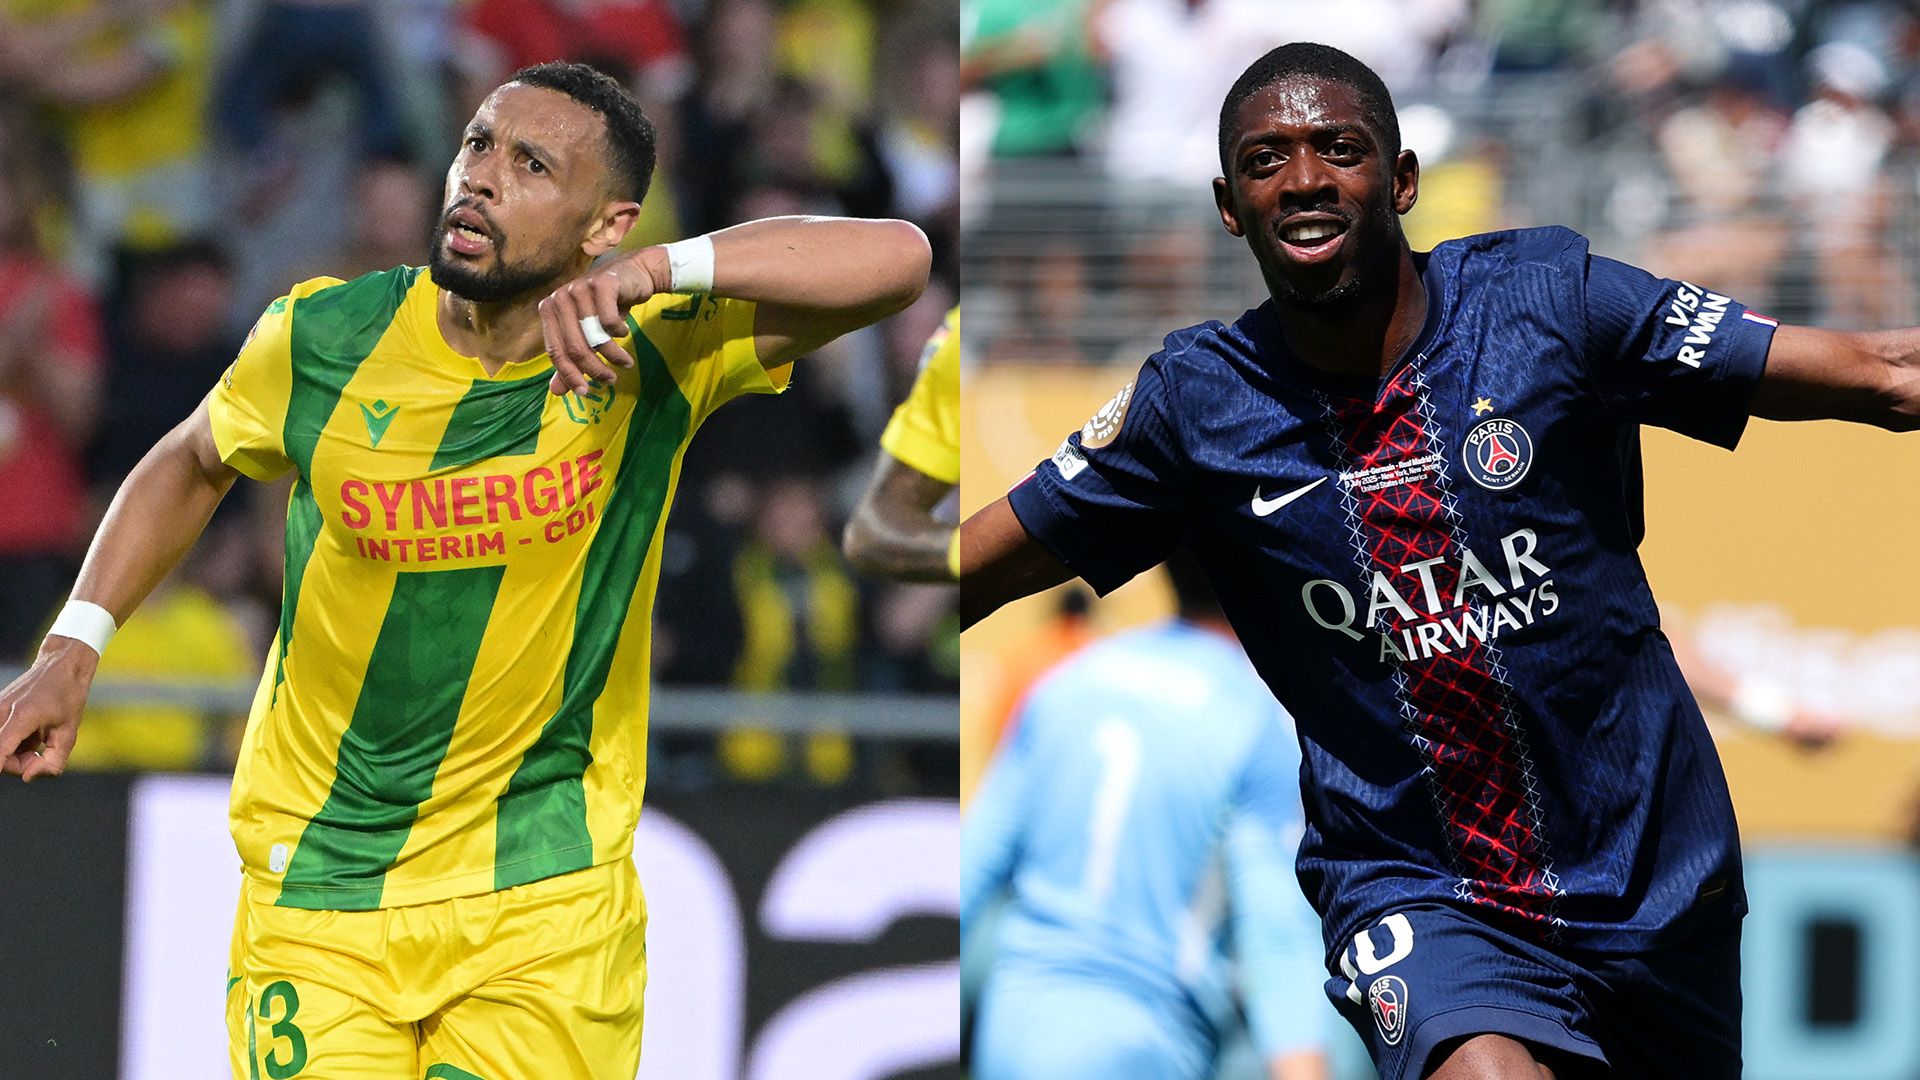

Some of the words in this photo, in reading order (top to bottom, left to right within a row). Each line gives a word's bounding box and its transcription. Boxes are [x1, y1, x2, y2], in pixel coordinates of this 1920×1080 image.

[1469, 421, 1514, 446] PARIS
[1398, 460, 1412, 468] Real
[1411, 455, 1432, 466] Madrid
[1361, 482, 1380, 493] United
[1379, 479, 1398, 489] States
[1404, 474, 1428, 483] America
[1362, 475, 1378, 485] 2025
[1381, 471, 1395, 480] New
[1409, 466, 1422, 474] New
[1482, 474, 1500, 483] SAINT
[340, 448, 604, 531] SYNERGIE
[355, 532, 506, 563] INTERIM
[543, 506, 596, 545] CDI
[1301, 527, 1551, 642] QATAR
[1379, 579, 1559, 663] AIRWAYS
